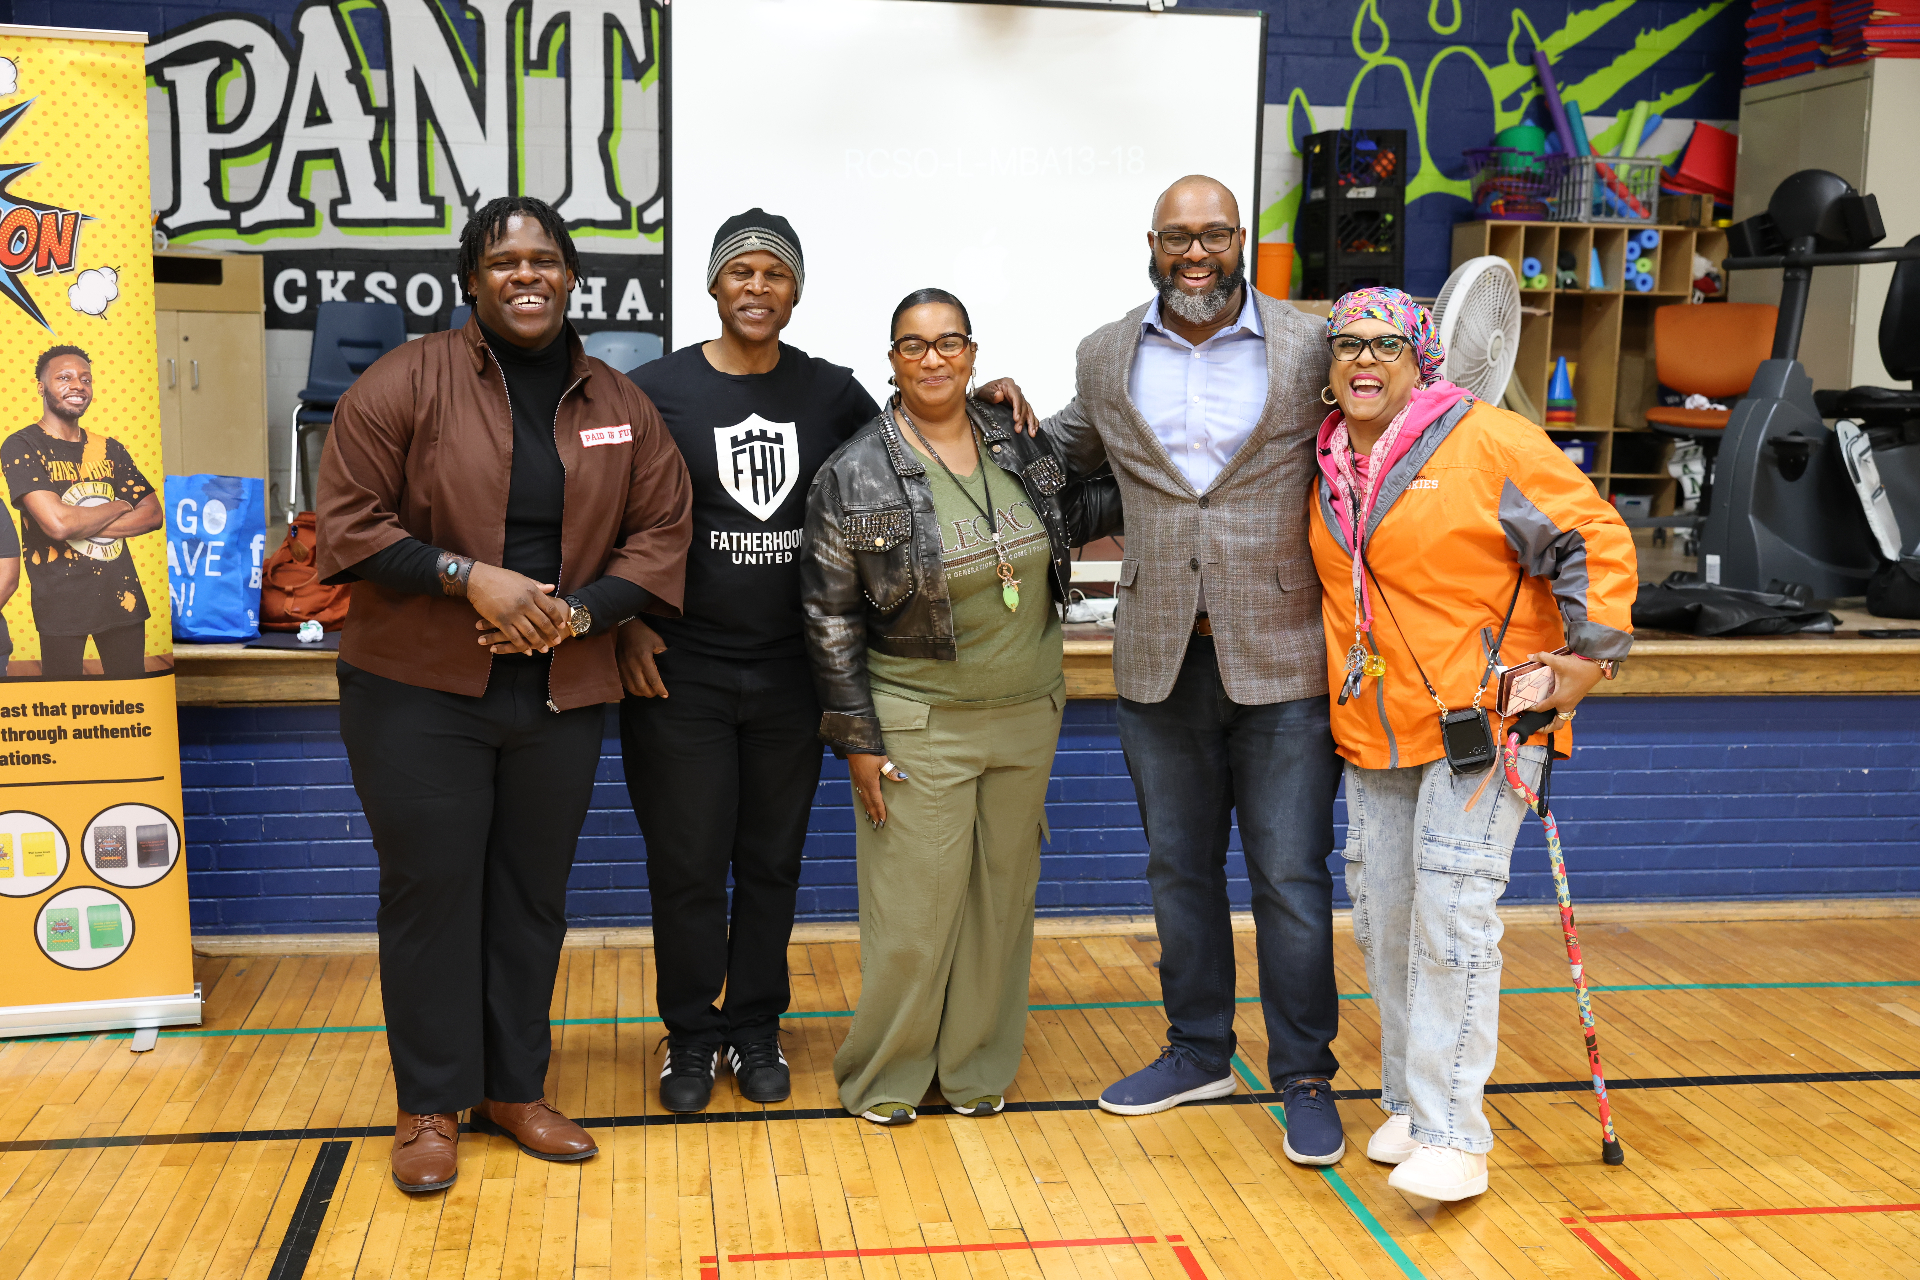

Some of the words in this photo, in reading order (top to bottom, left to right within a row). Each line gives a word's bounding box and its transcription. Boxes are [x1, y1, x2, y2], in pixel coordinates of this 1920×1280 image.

[147, 0, 664, 232] PANT
[845, 144, 1146, 179] RCSO-L-MBA13-18
[567, 266, 664, 321] HA
[584, 432, 605, 442] PAID
[618, 428, 632, 439] FU
[176, 498, 227, 536] GO
[938, 501, 1037, 554] LEGAC
[732, 551, 793, 565] UNITED
[0, 703, 28, 718] ast
[32, 701, 67, 717] that
[72, 699, 145, 720] provides
[1, 725, 68, 745] through
[72, 722, 152, 740] authentic
[0, 750, 57, 767] ations.
